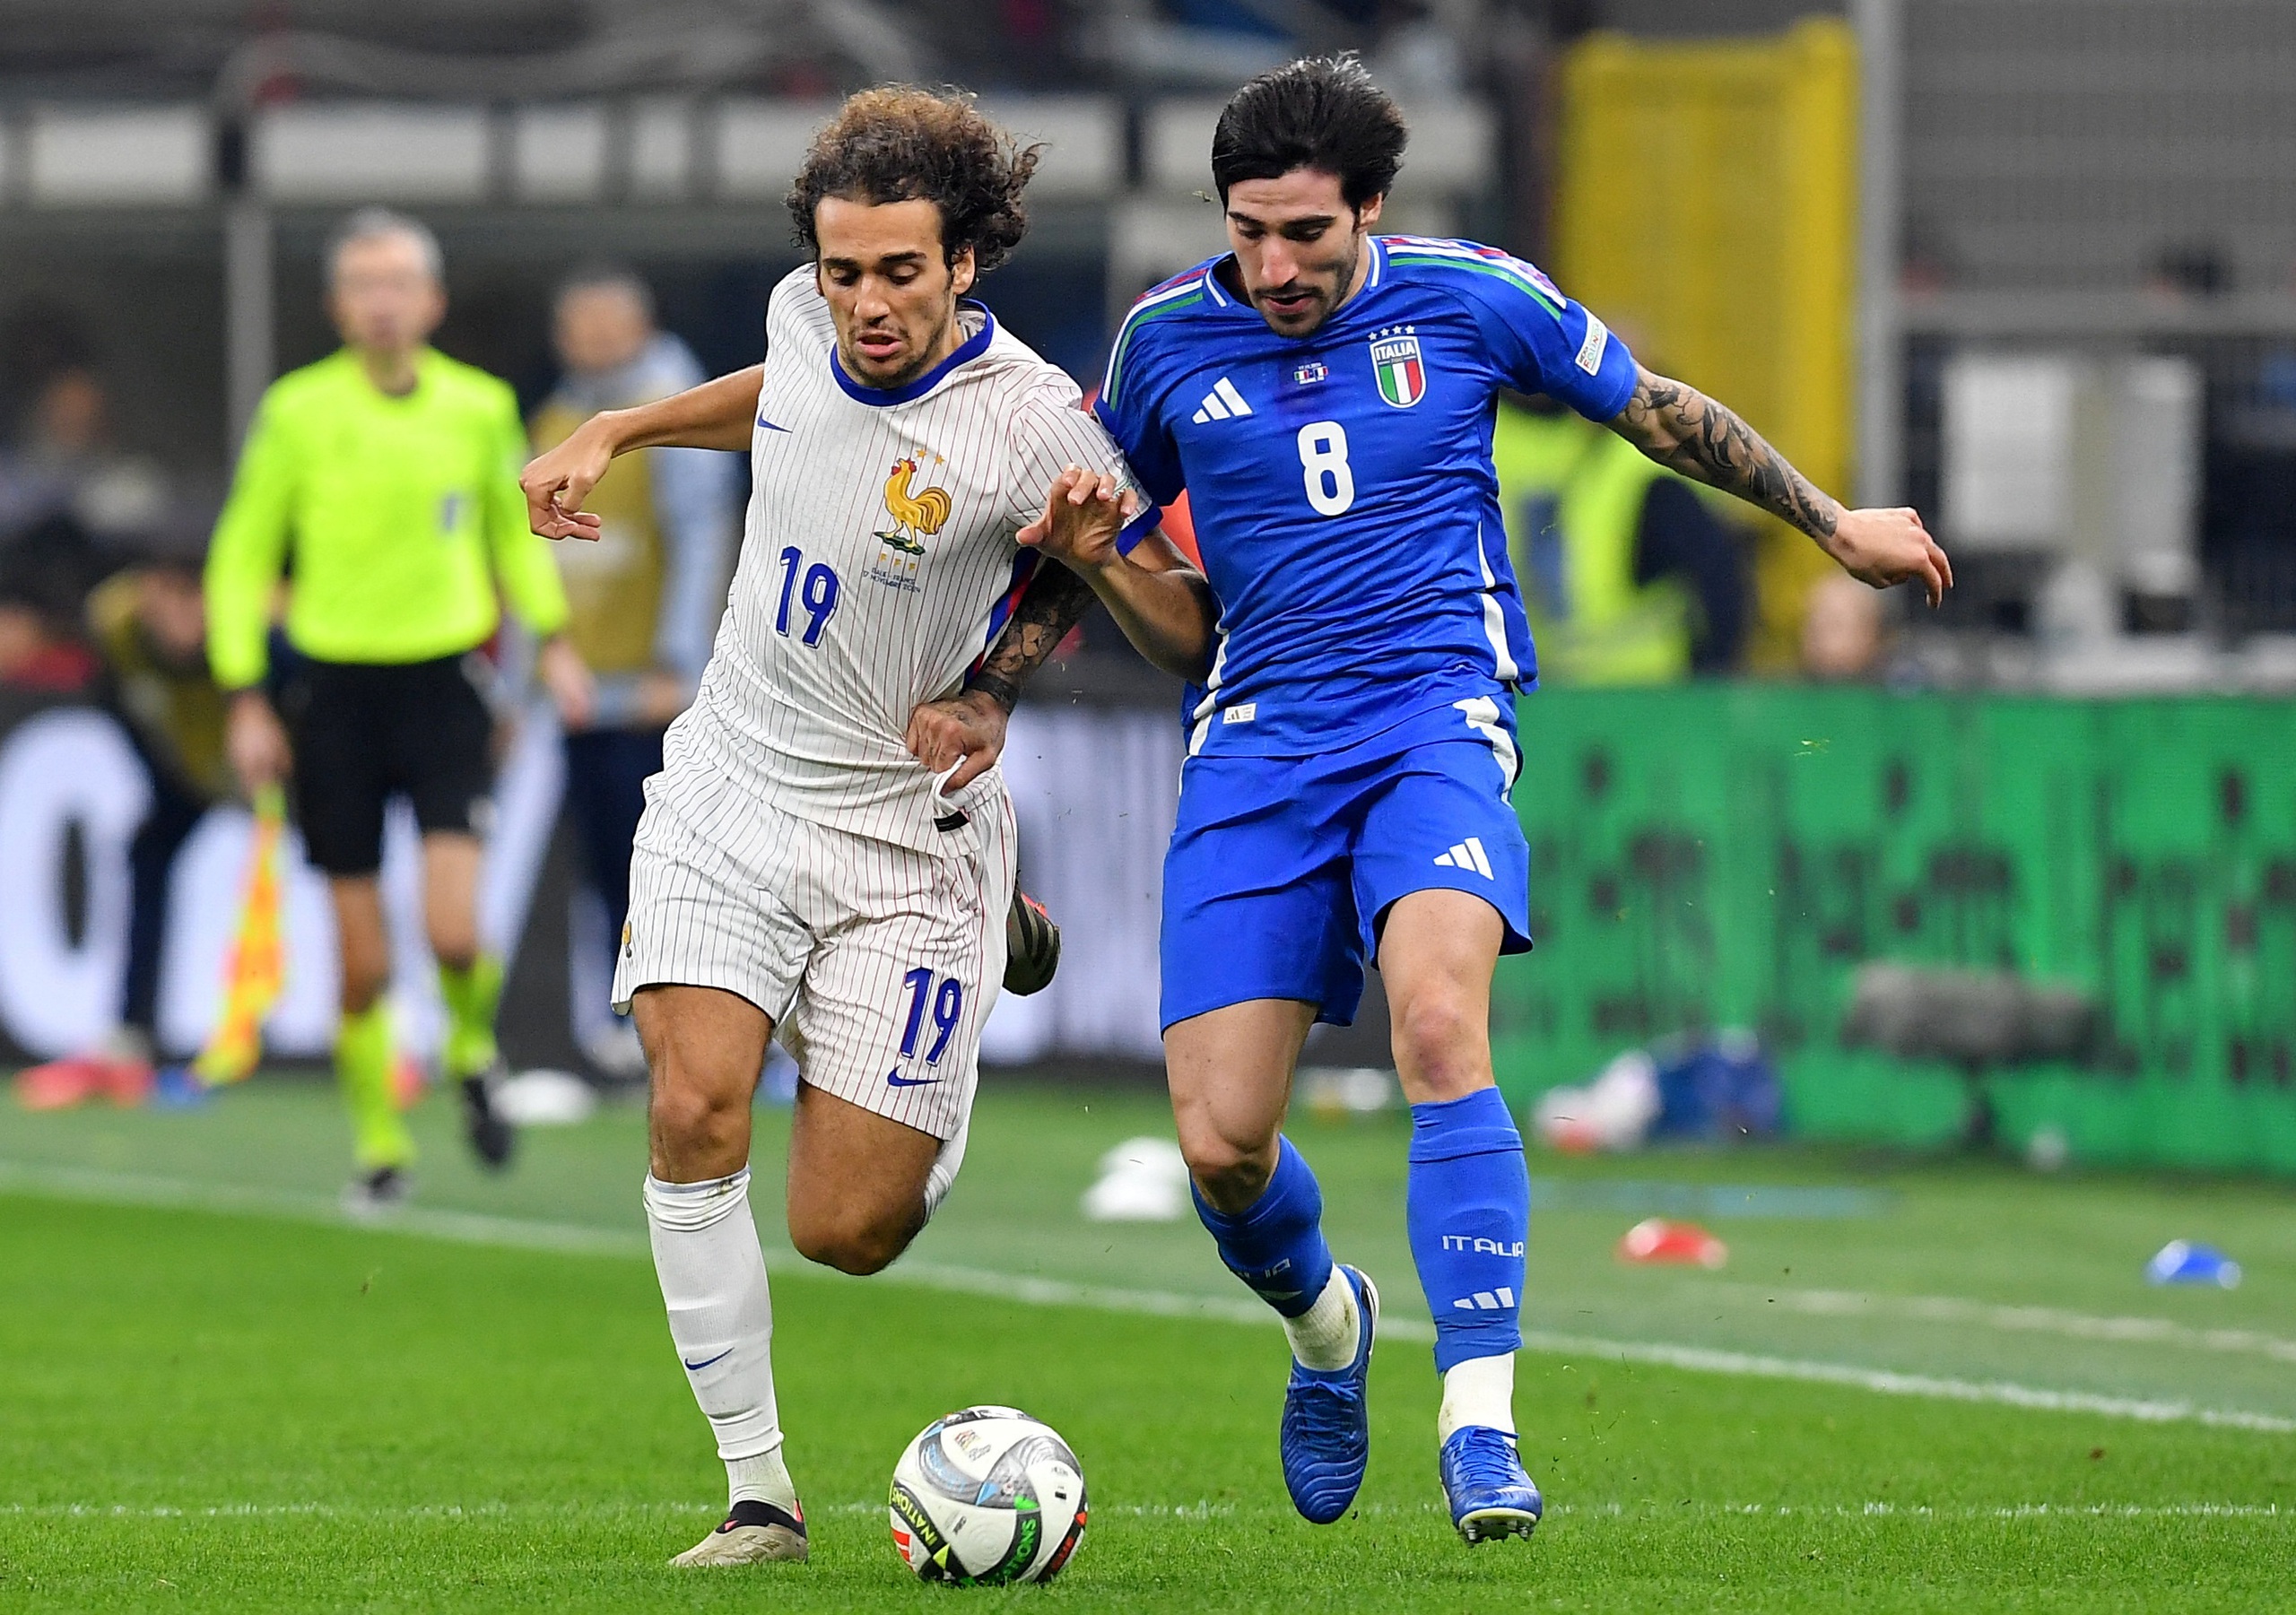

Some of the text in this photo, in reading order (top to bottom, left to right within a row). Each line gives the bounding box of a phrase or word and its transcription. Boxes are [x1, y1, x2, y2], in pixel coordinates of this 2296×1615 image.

[1374, 342, 1416, 361] ITALIA
[1297, 421, 1355, 517] 8
[776, 545, 841, 649] 19
[900, 967, 961, 1067] 19
[1441, 1235, 1524, 1257] ITALIA
